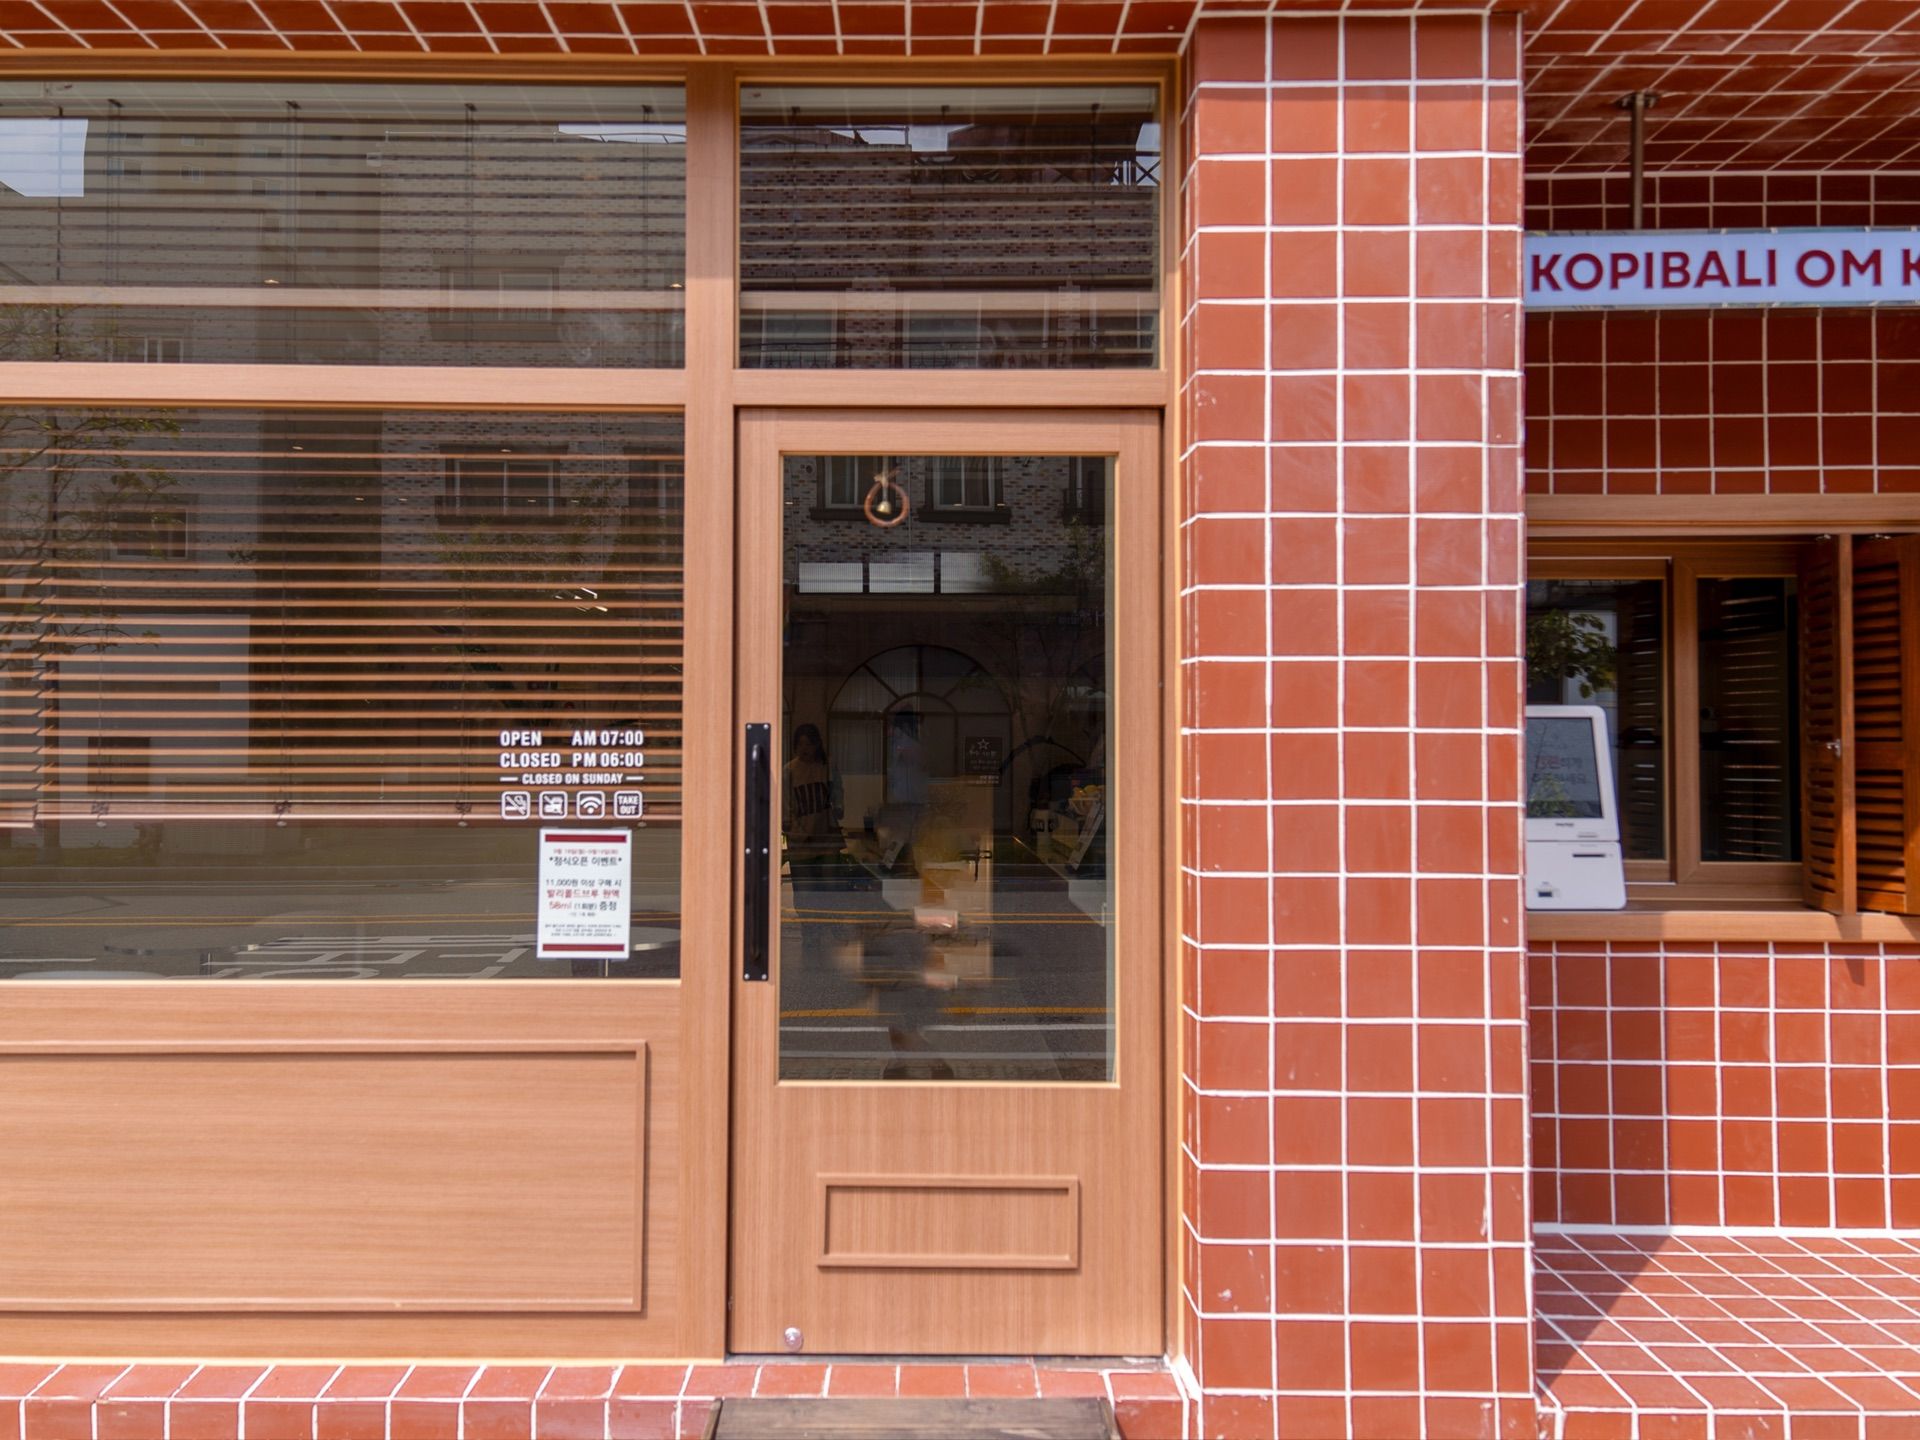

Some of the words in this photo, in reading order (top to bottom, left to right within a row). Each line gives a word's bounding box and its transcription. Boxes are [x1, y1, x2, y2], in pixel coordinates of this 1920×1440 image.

[1531, 249, 1778, 292] KOPIBALI
[1796, 248, 1883, 288] OM
[500, 730, 542, 746] OPEN
[571, 730, 597, 746] AM
[600, 730, 644, 746] 07:00
[500, 752, 561, 768] CLOSED
[572, 752, 597, 768] PM
[600, 752, 644, 768] 06:00
[522, 773, 562, 784] CLOSED
[565, 773, 580, 784] ON
[582, 773, 623, 784] SUNDAY
[618, 795, 639, 805] TAKE
[619, 805, 637, 815] OUT
